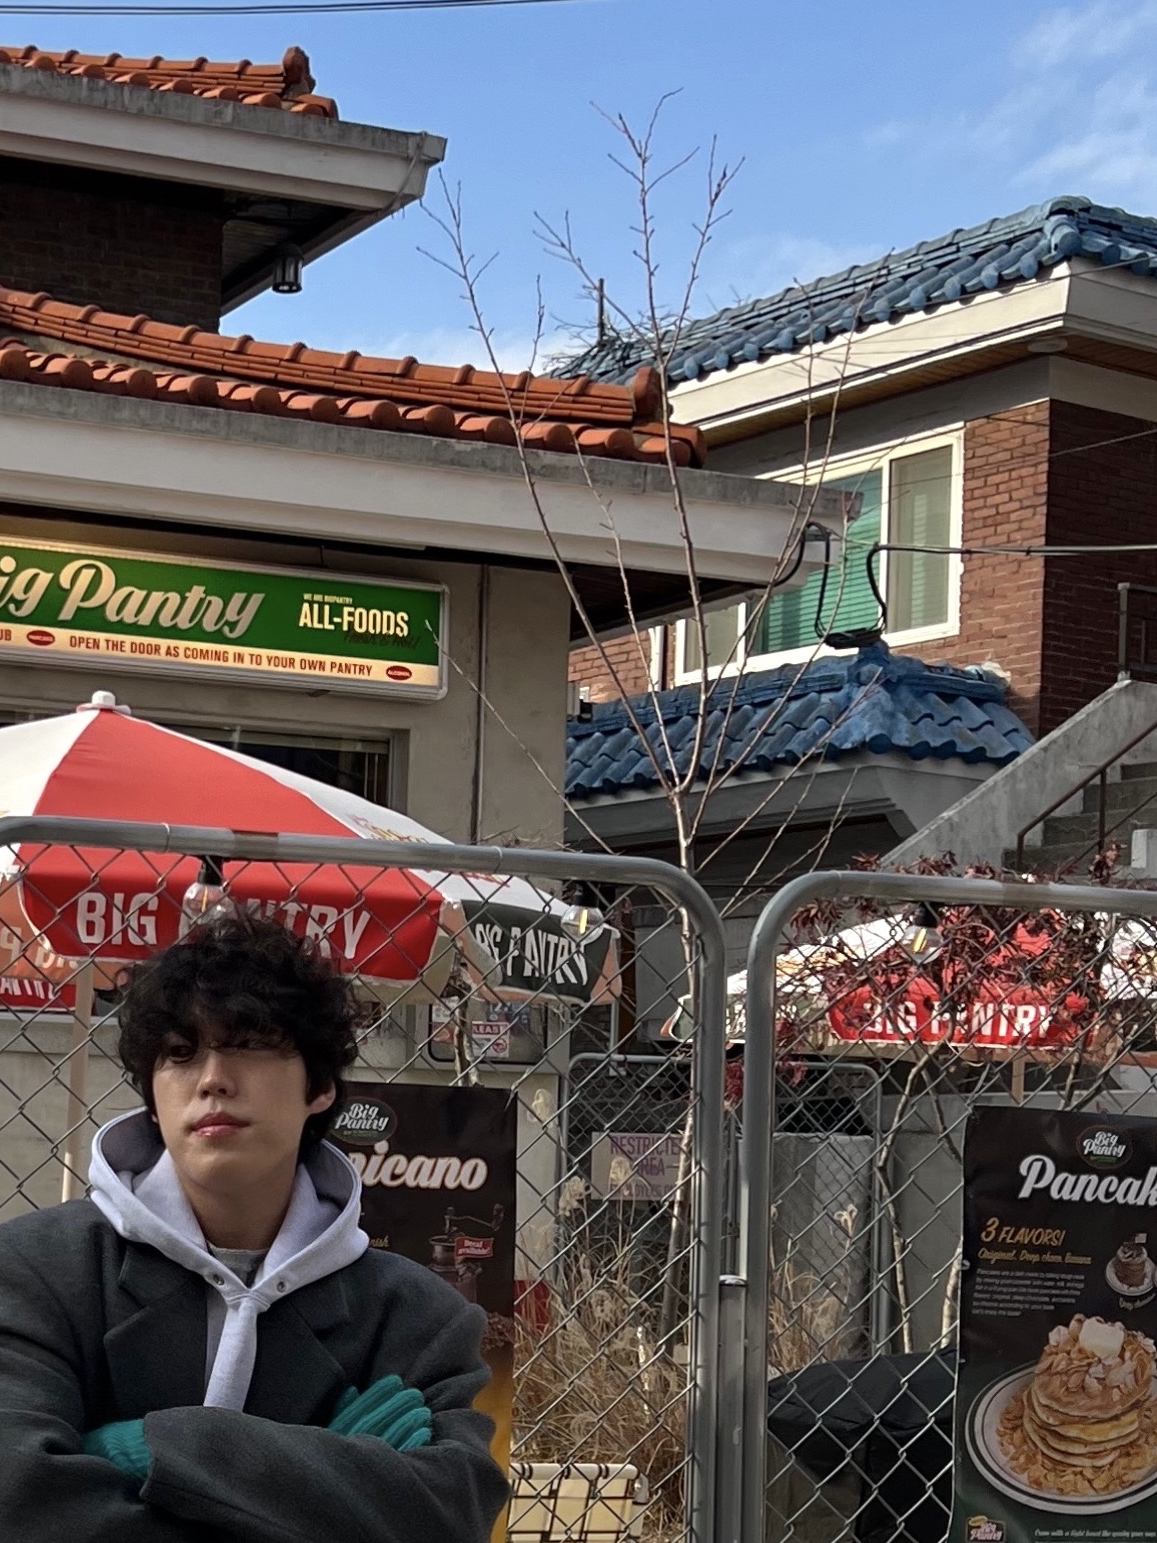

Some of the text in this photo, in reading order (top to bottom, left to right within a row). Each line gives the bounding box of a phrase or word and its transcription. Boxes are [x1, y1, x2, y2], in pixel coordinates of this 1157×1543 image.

[57, 559, 266, 639] Pantry
[298, 602, 409, 637] ALL-FOODS
[69, 635, 373, 677] OPEN THE DOOR AS COMING IN TO YOUR OWN PANTRY
[76, 892, 158, 946] BIG
[930, 1002, 1055, 1039] PNTRY
[334, 1111, 390, 1132] Pantry
[348, 1102, 379, 1120] Big
[610, 1136, 683, 1155] RESTRICTE
[1094, 1130, 1119, 1147] Big
[981, 1217, 1066, 1246] 3 FLAVORS!
